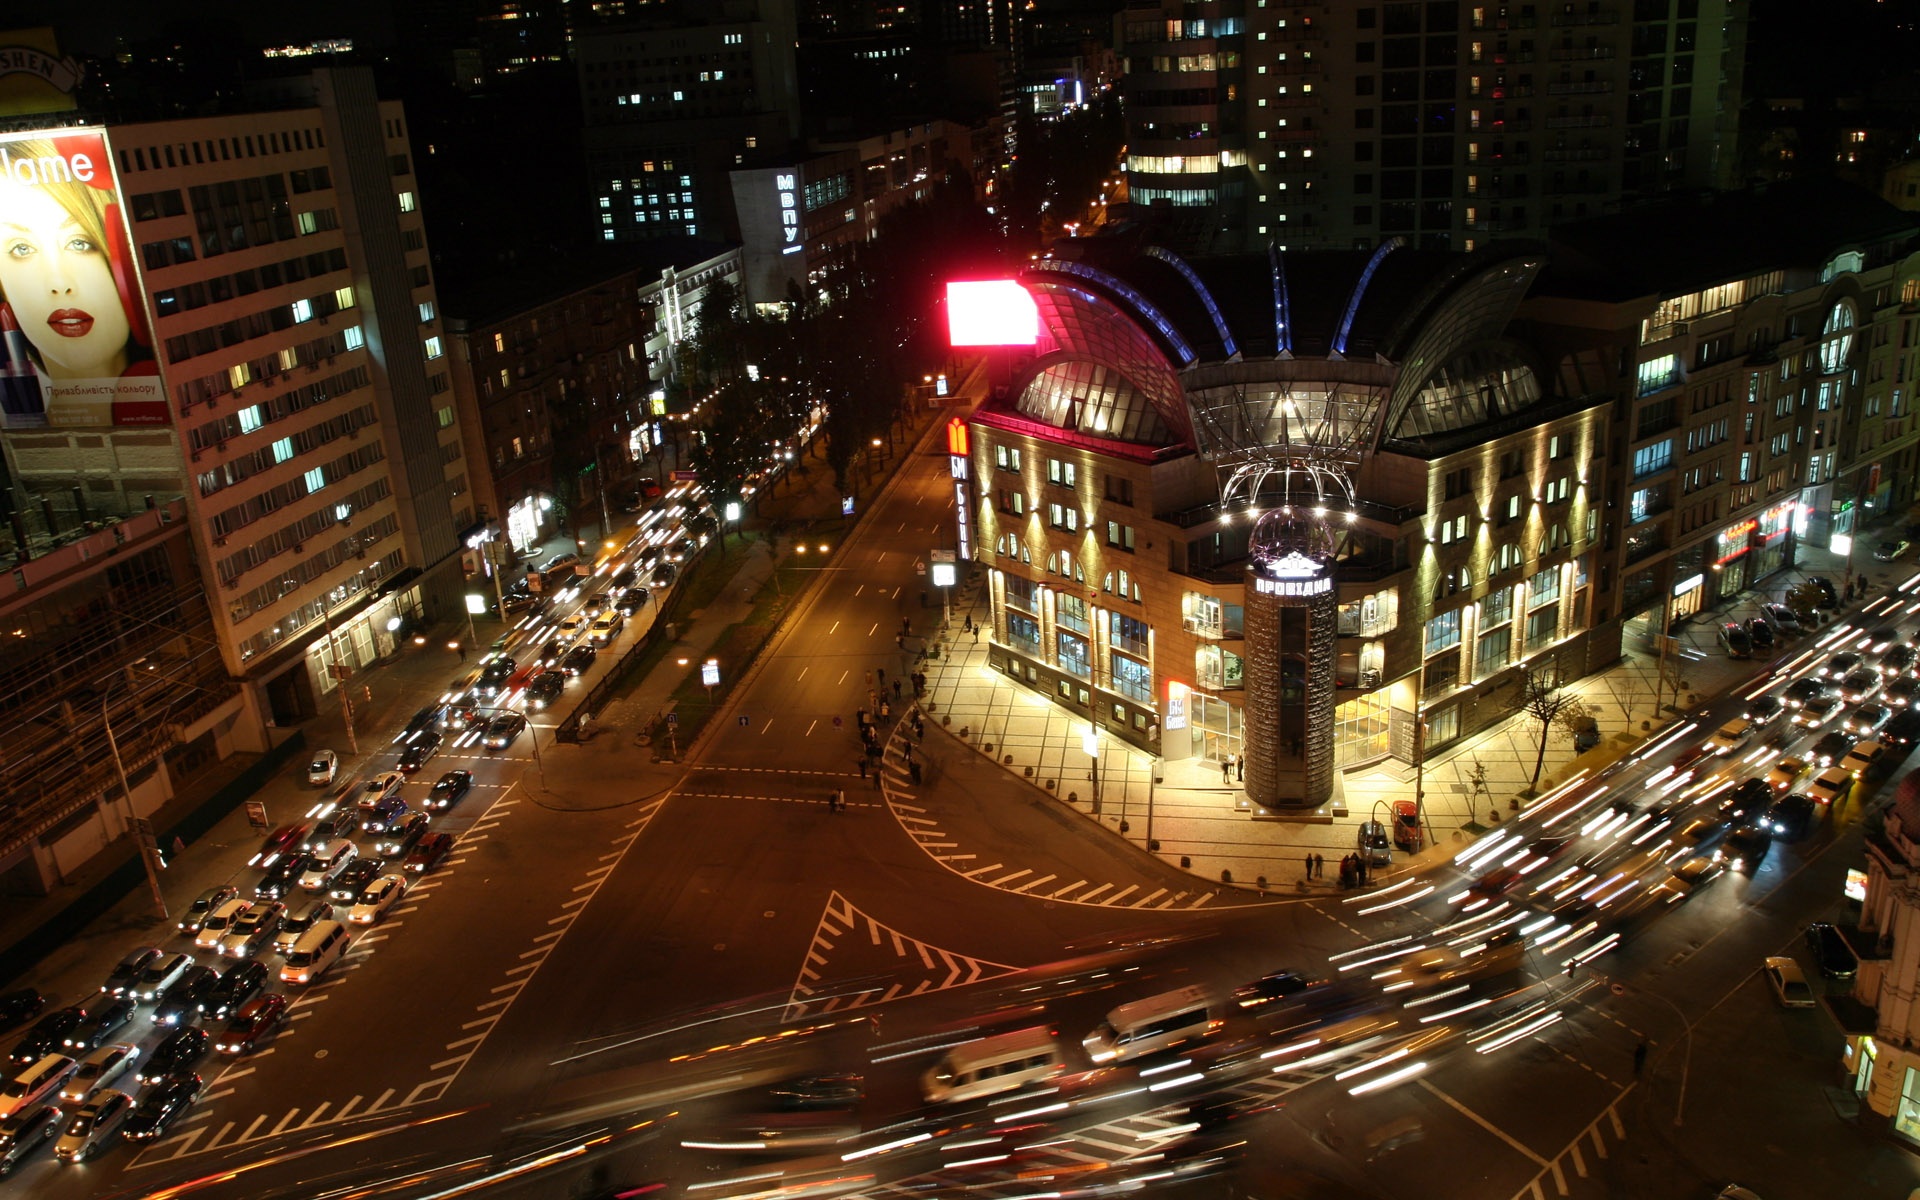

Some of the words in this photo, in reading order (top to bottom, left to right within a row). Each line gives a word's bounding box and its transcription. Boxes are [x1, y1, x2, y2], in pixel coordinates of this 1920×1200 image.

[0, 147, 95, 186] lame
[776, 174, 798, 242] МВПУ
[45, 384, 115, 399] Привабливість
[116, 384, 157, 396] кольору
[950, 455, 967, 480] БМ
[956, 483, 970, 559] Банк
[1256, 577, 1332, 597] ПРОВІДНА
